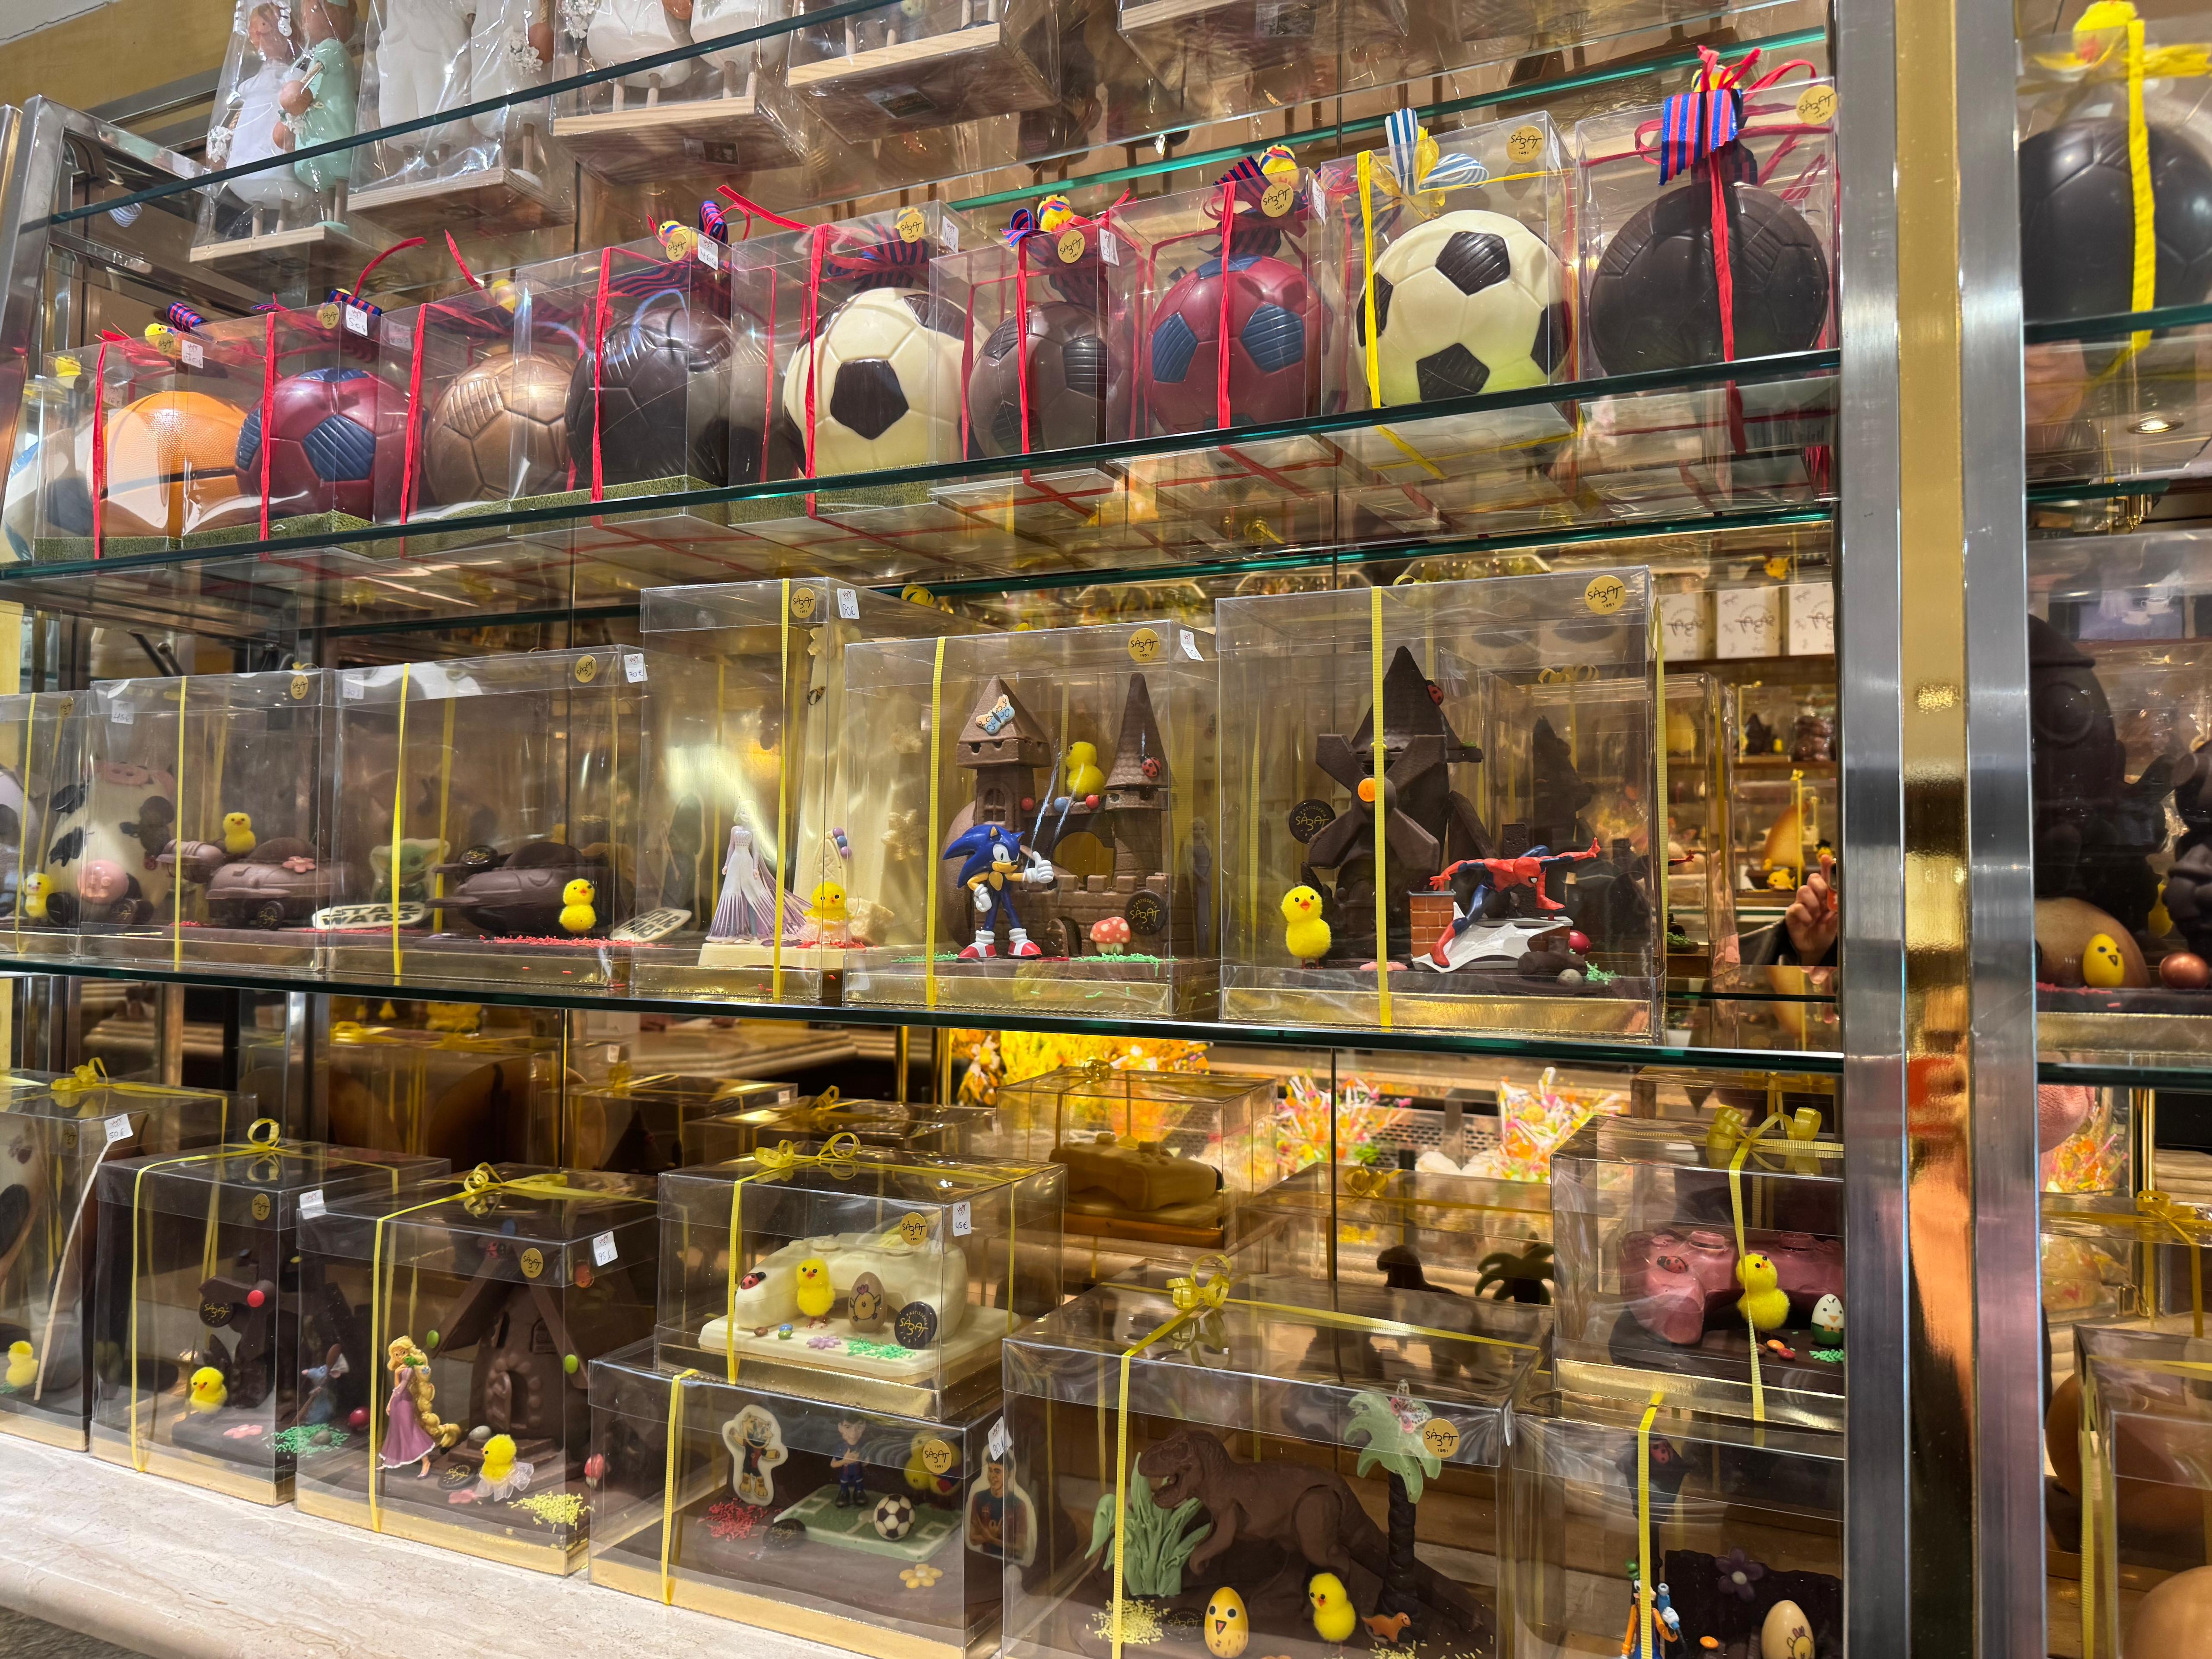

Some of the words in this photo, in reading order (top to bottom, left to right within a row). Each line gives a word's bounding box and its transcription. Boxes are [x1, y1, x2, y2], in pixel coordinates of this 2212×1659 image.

[1300, 806, 1327, 817] PASTISSERIA
[1133, 898, 1157, 908] PASTISSERIA
[322, 912, 419, 925] WARS
[639, 910, 681, 928] STAR
[955, 1221, 968, 1230] 45€
